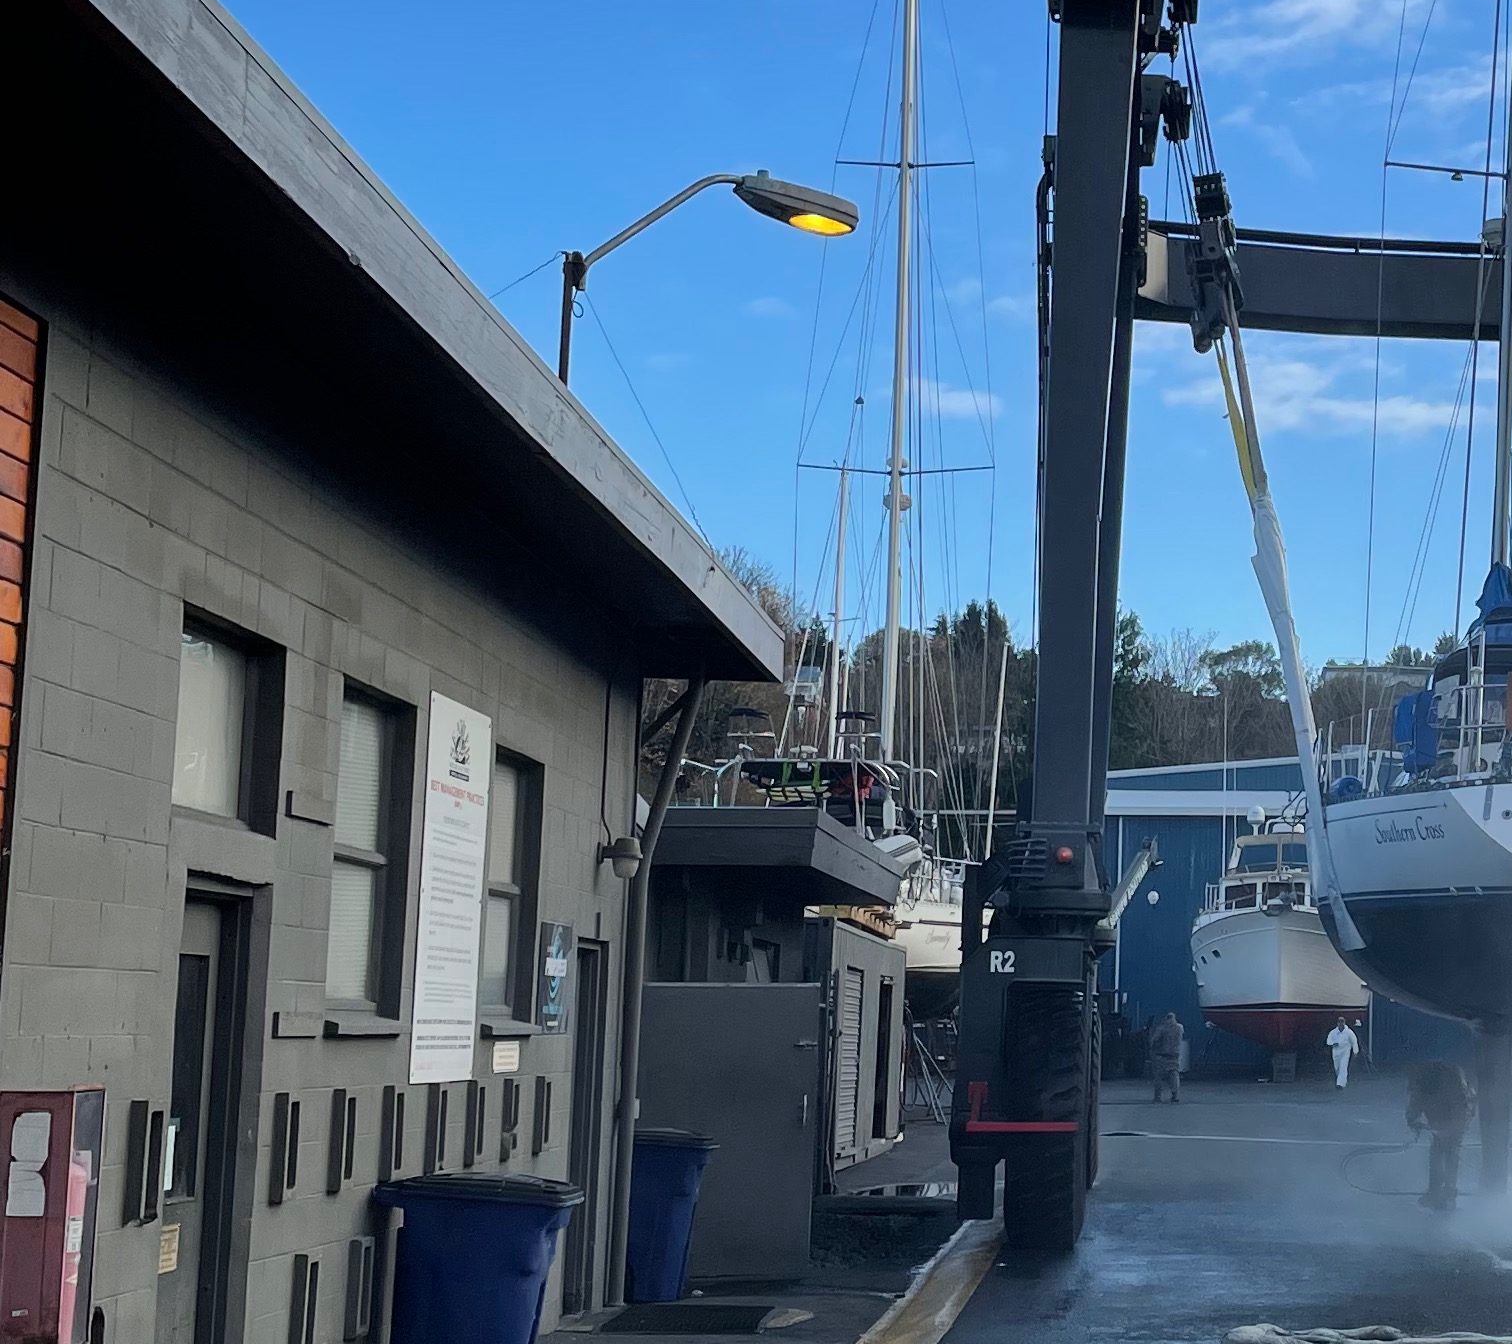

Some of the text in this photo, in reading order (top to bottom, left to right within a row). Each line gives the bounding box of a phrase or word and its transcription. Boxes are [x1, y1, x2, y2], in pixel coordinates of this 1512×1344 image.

[1375, 816, 1445, 844] Southern Cross
[990, 950, 1015, 973] R2
